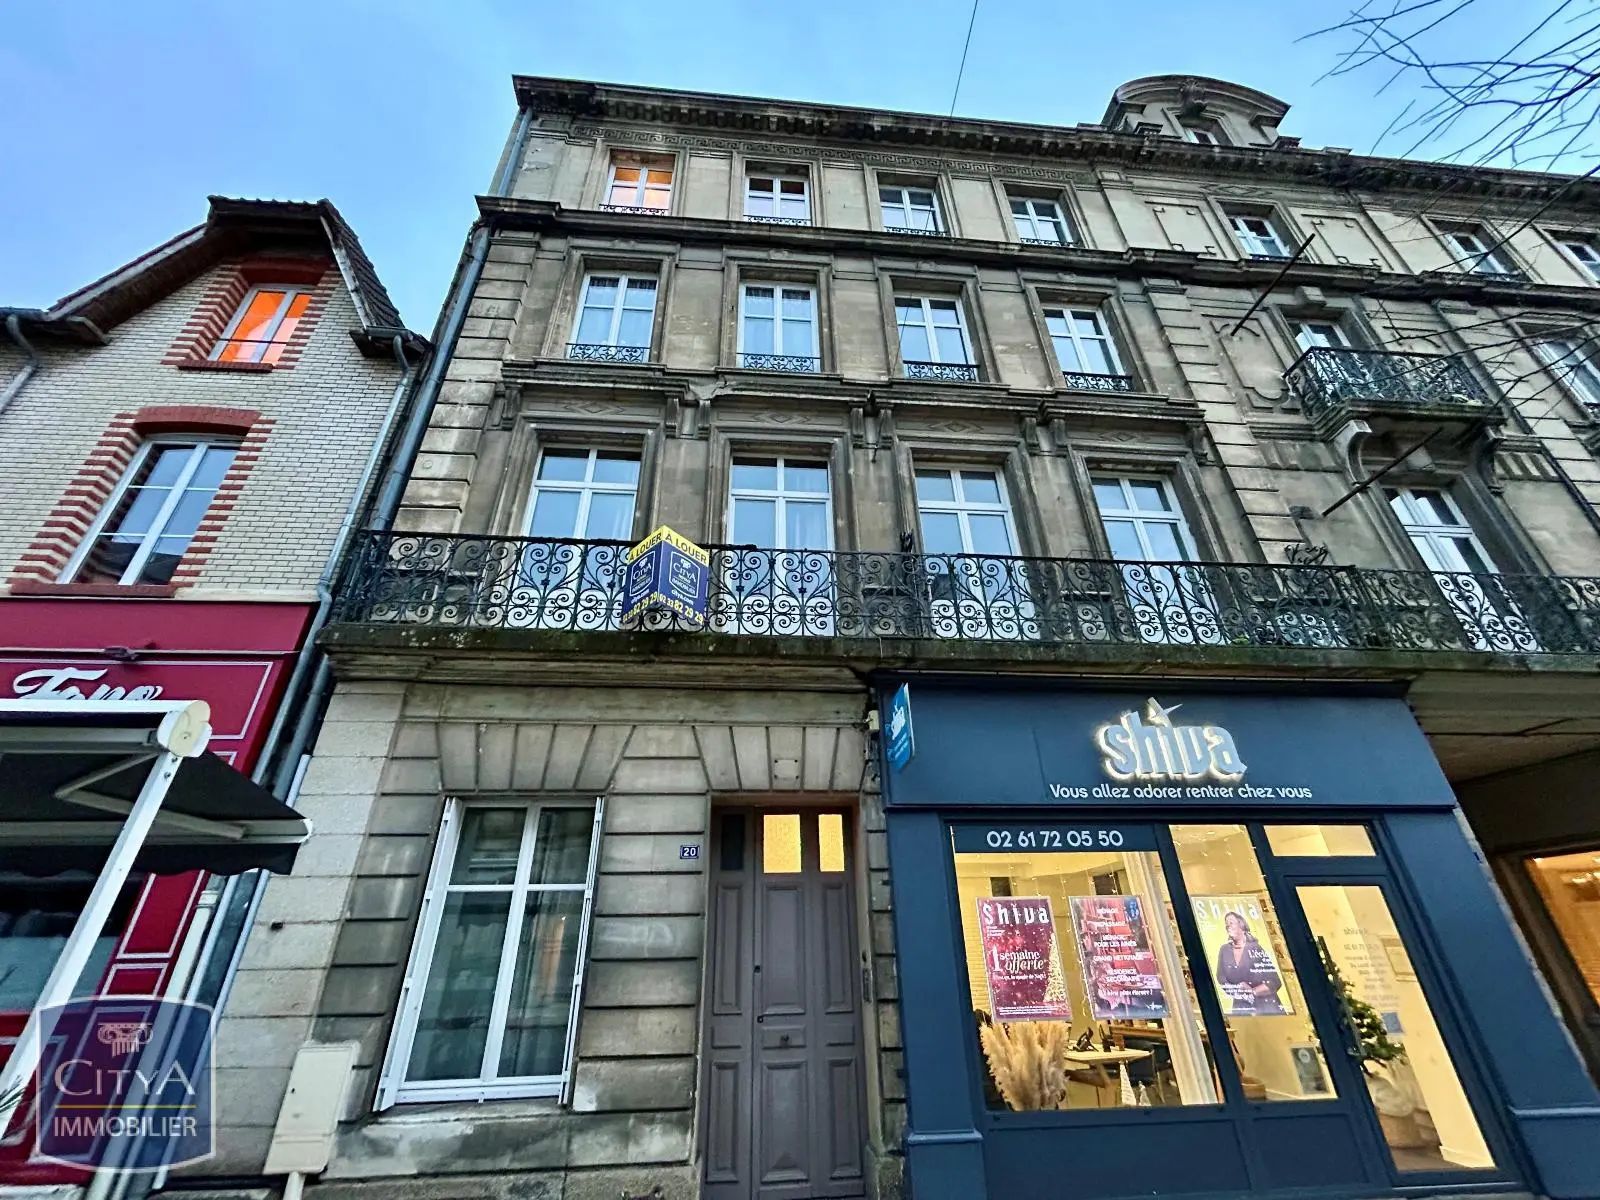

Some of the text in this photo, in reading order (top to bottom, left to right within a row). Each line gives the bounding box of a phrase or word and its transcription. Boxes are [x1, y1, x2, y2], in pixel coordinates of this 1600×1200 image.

[636, 533, 662, 557] LOUER
[675, 538, 707, 564] LOUER
[1050, 784, 1313, 799] Vous allez adorer rentrer chez vous
[986, 830, 1124, 848] 02 61 72 05 50
[683, 847, 696, 856] 20
[1000, 949, 1040, 962] semaine
